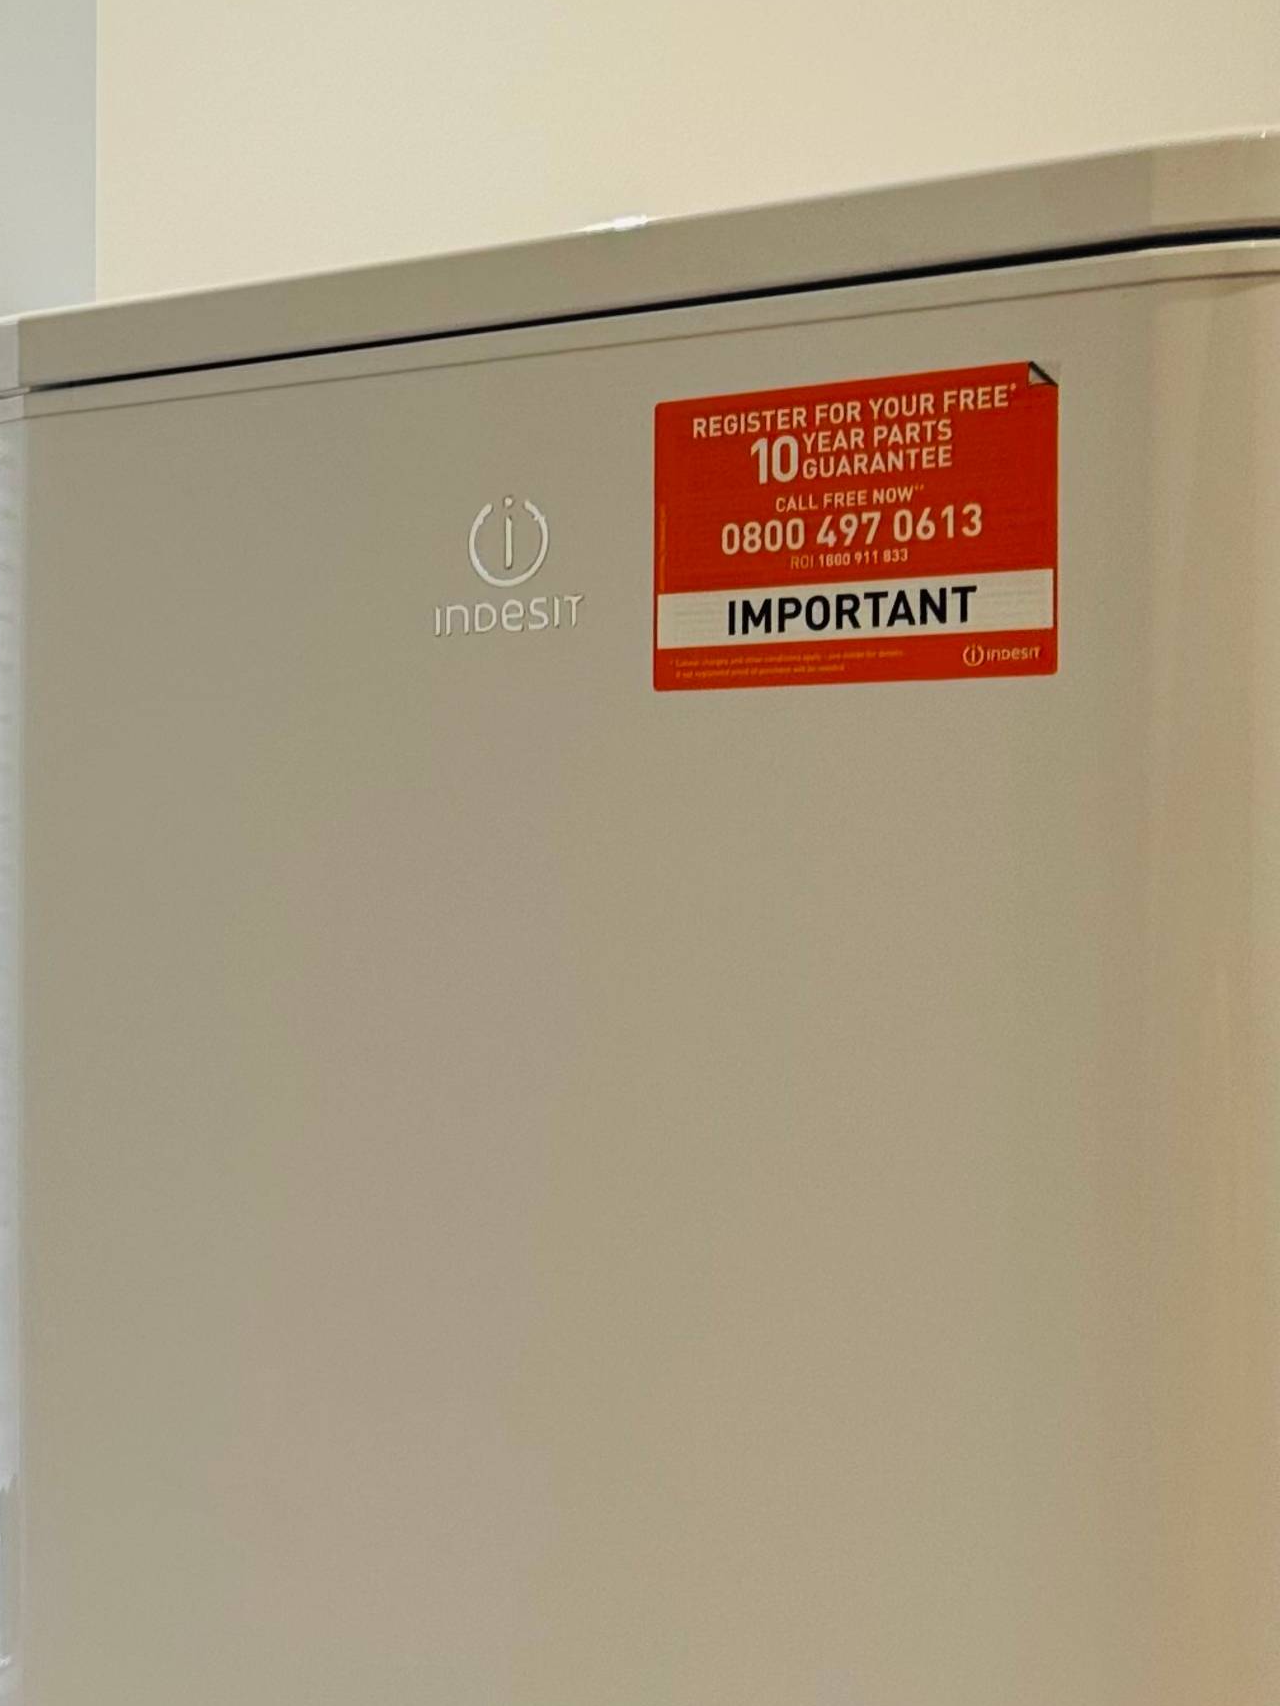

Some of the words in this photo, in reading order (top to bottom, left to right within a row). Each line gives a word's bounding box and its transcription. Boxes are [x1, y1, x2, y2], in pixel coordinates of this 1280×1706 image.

[692, 408, 808, 438] REGISTER
[814, 399, 861, 427] FOR
[869, 393, 935, 421] YOUR
[802, 427, 865, 454] YEAR
[873, 419, 953, 448] PARTS
[750, 434, 800, 485] 10
[802, 445, 953, 480] GUARANTEE
[775, 495, 818, 514] CALL
[823, 489, 868, 509] FREE
[721, 518, 805, 555] 0800
[816, 512, 881, 549] 497
[892, 503, 983, 543] 0613
[790, 555, 815, 570] ROI
[818, 553, 851, 568] 1800
[854, 551, 879, 565] 911
[883, 548, 908, 564] 833
[727, 585, 978, 636] IMPORTANT
